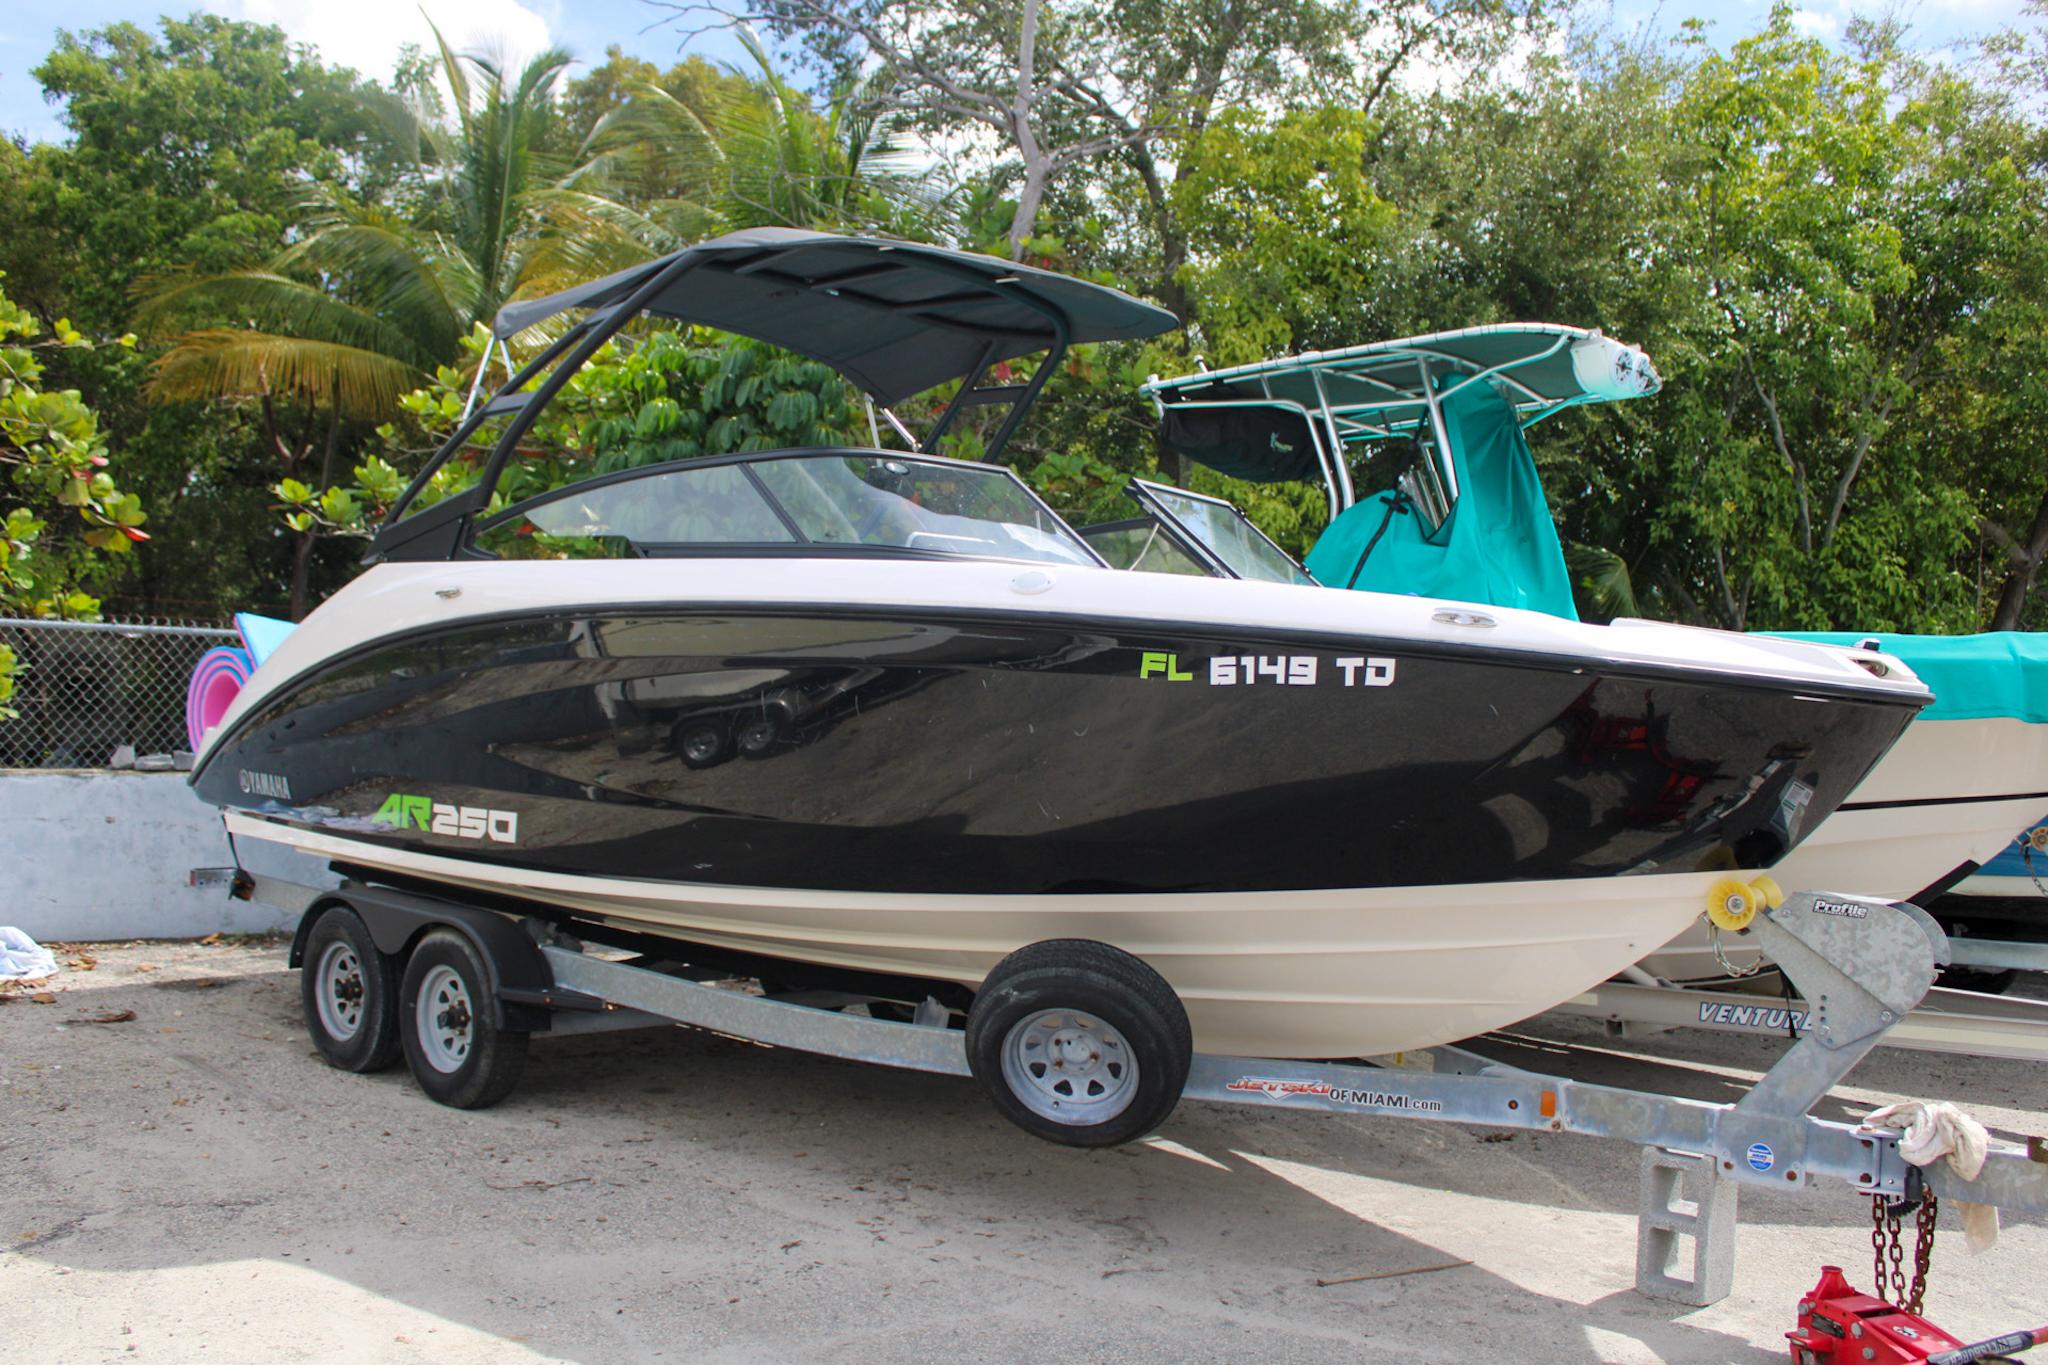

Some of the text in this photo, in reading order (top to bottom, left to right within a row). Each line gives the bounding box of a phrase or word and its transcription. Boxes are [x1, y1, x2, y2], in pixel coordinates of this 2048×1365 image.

[1140, 652, 1396, 687] FL 6149 TD
[248, 770, 292, 800] YAMAHA
[371, 793, 518, 844] AR250
[1813, 899, 1868, 916] Profile
[1329, 1088, 1349, 1101] OF
